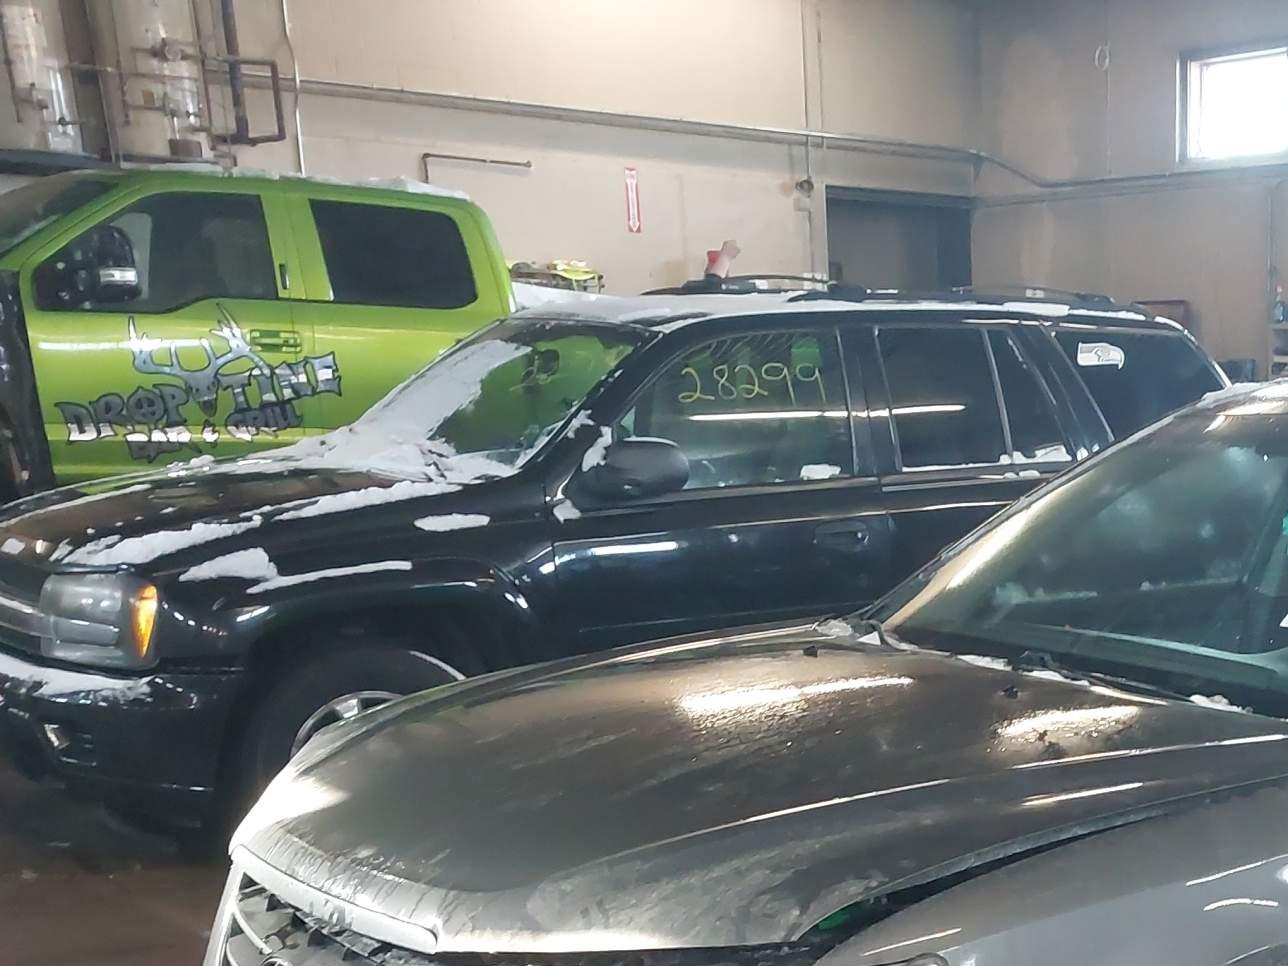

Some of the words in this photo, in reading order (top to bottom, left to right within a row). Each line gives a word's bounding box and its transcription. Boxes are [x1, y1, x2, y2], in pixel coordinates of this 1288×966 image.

[54, 384, 190, 445] DROP
[217, 351, 342, 411] TINE
[678, 362, 826, 406] 28299
